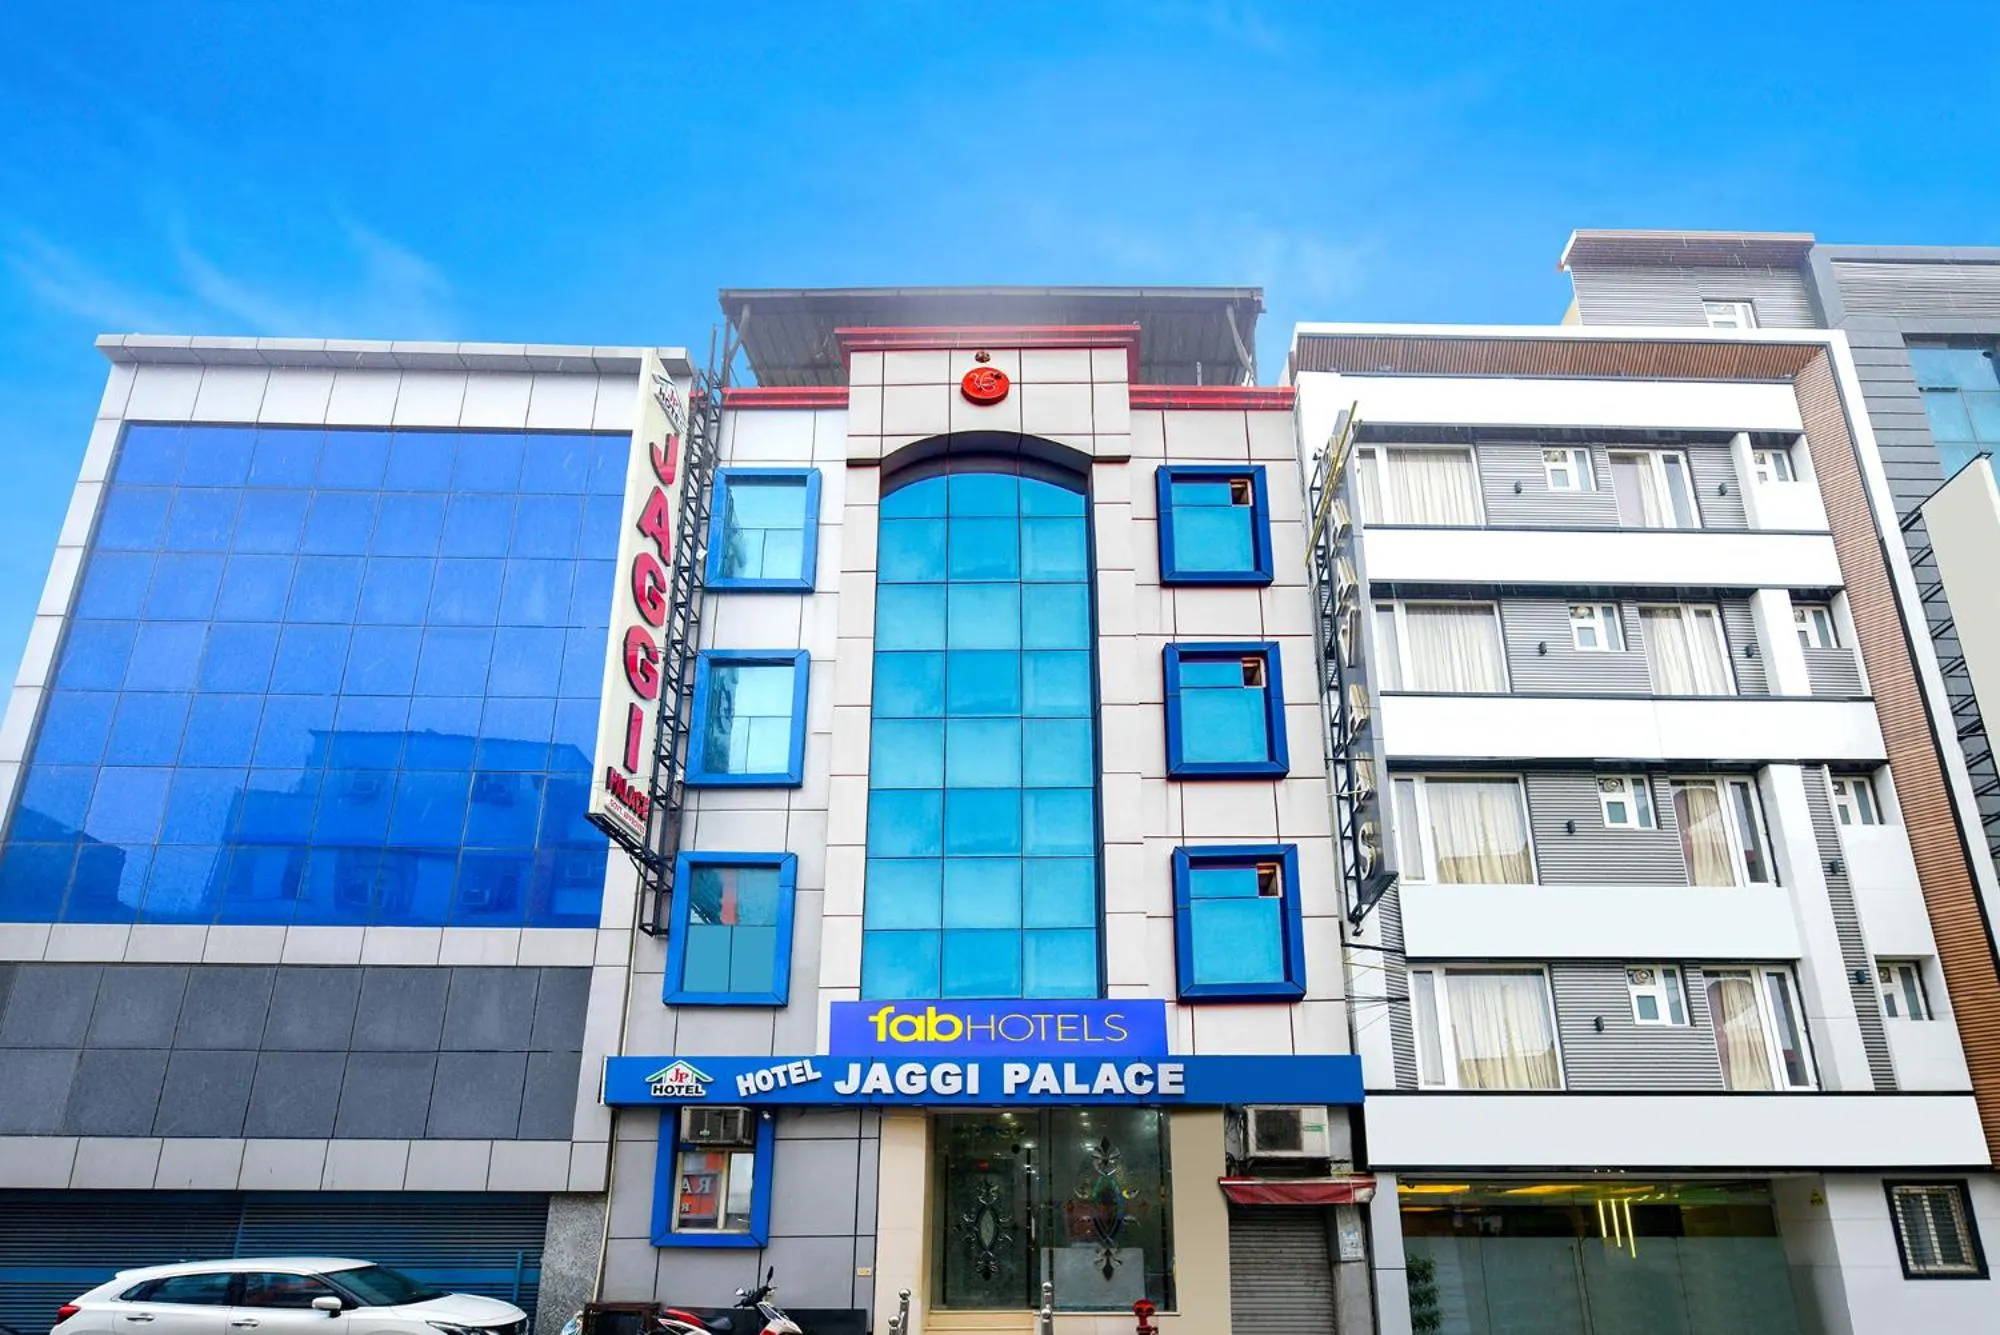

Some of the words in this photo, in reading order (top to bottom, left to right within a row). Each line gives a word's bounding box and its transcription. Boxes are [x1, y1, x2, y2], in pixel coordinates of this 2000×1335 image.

[623, 432, 679, 774] JAGGI
[606, 766, 651, 821] PALACE
[652, 1084, 704, 1095] HOTEL
[736, 1059, 822, 1097] HOTEL
[834, 1063, 979, 1096] JAGGI
[1003, 1063, 1185, 1096] PALACE
